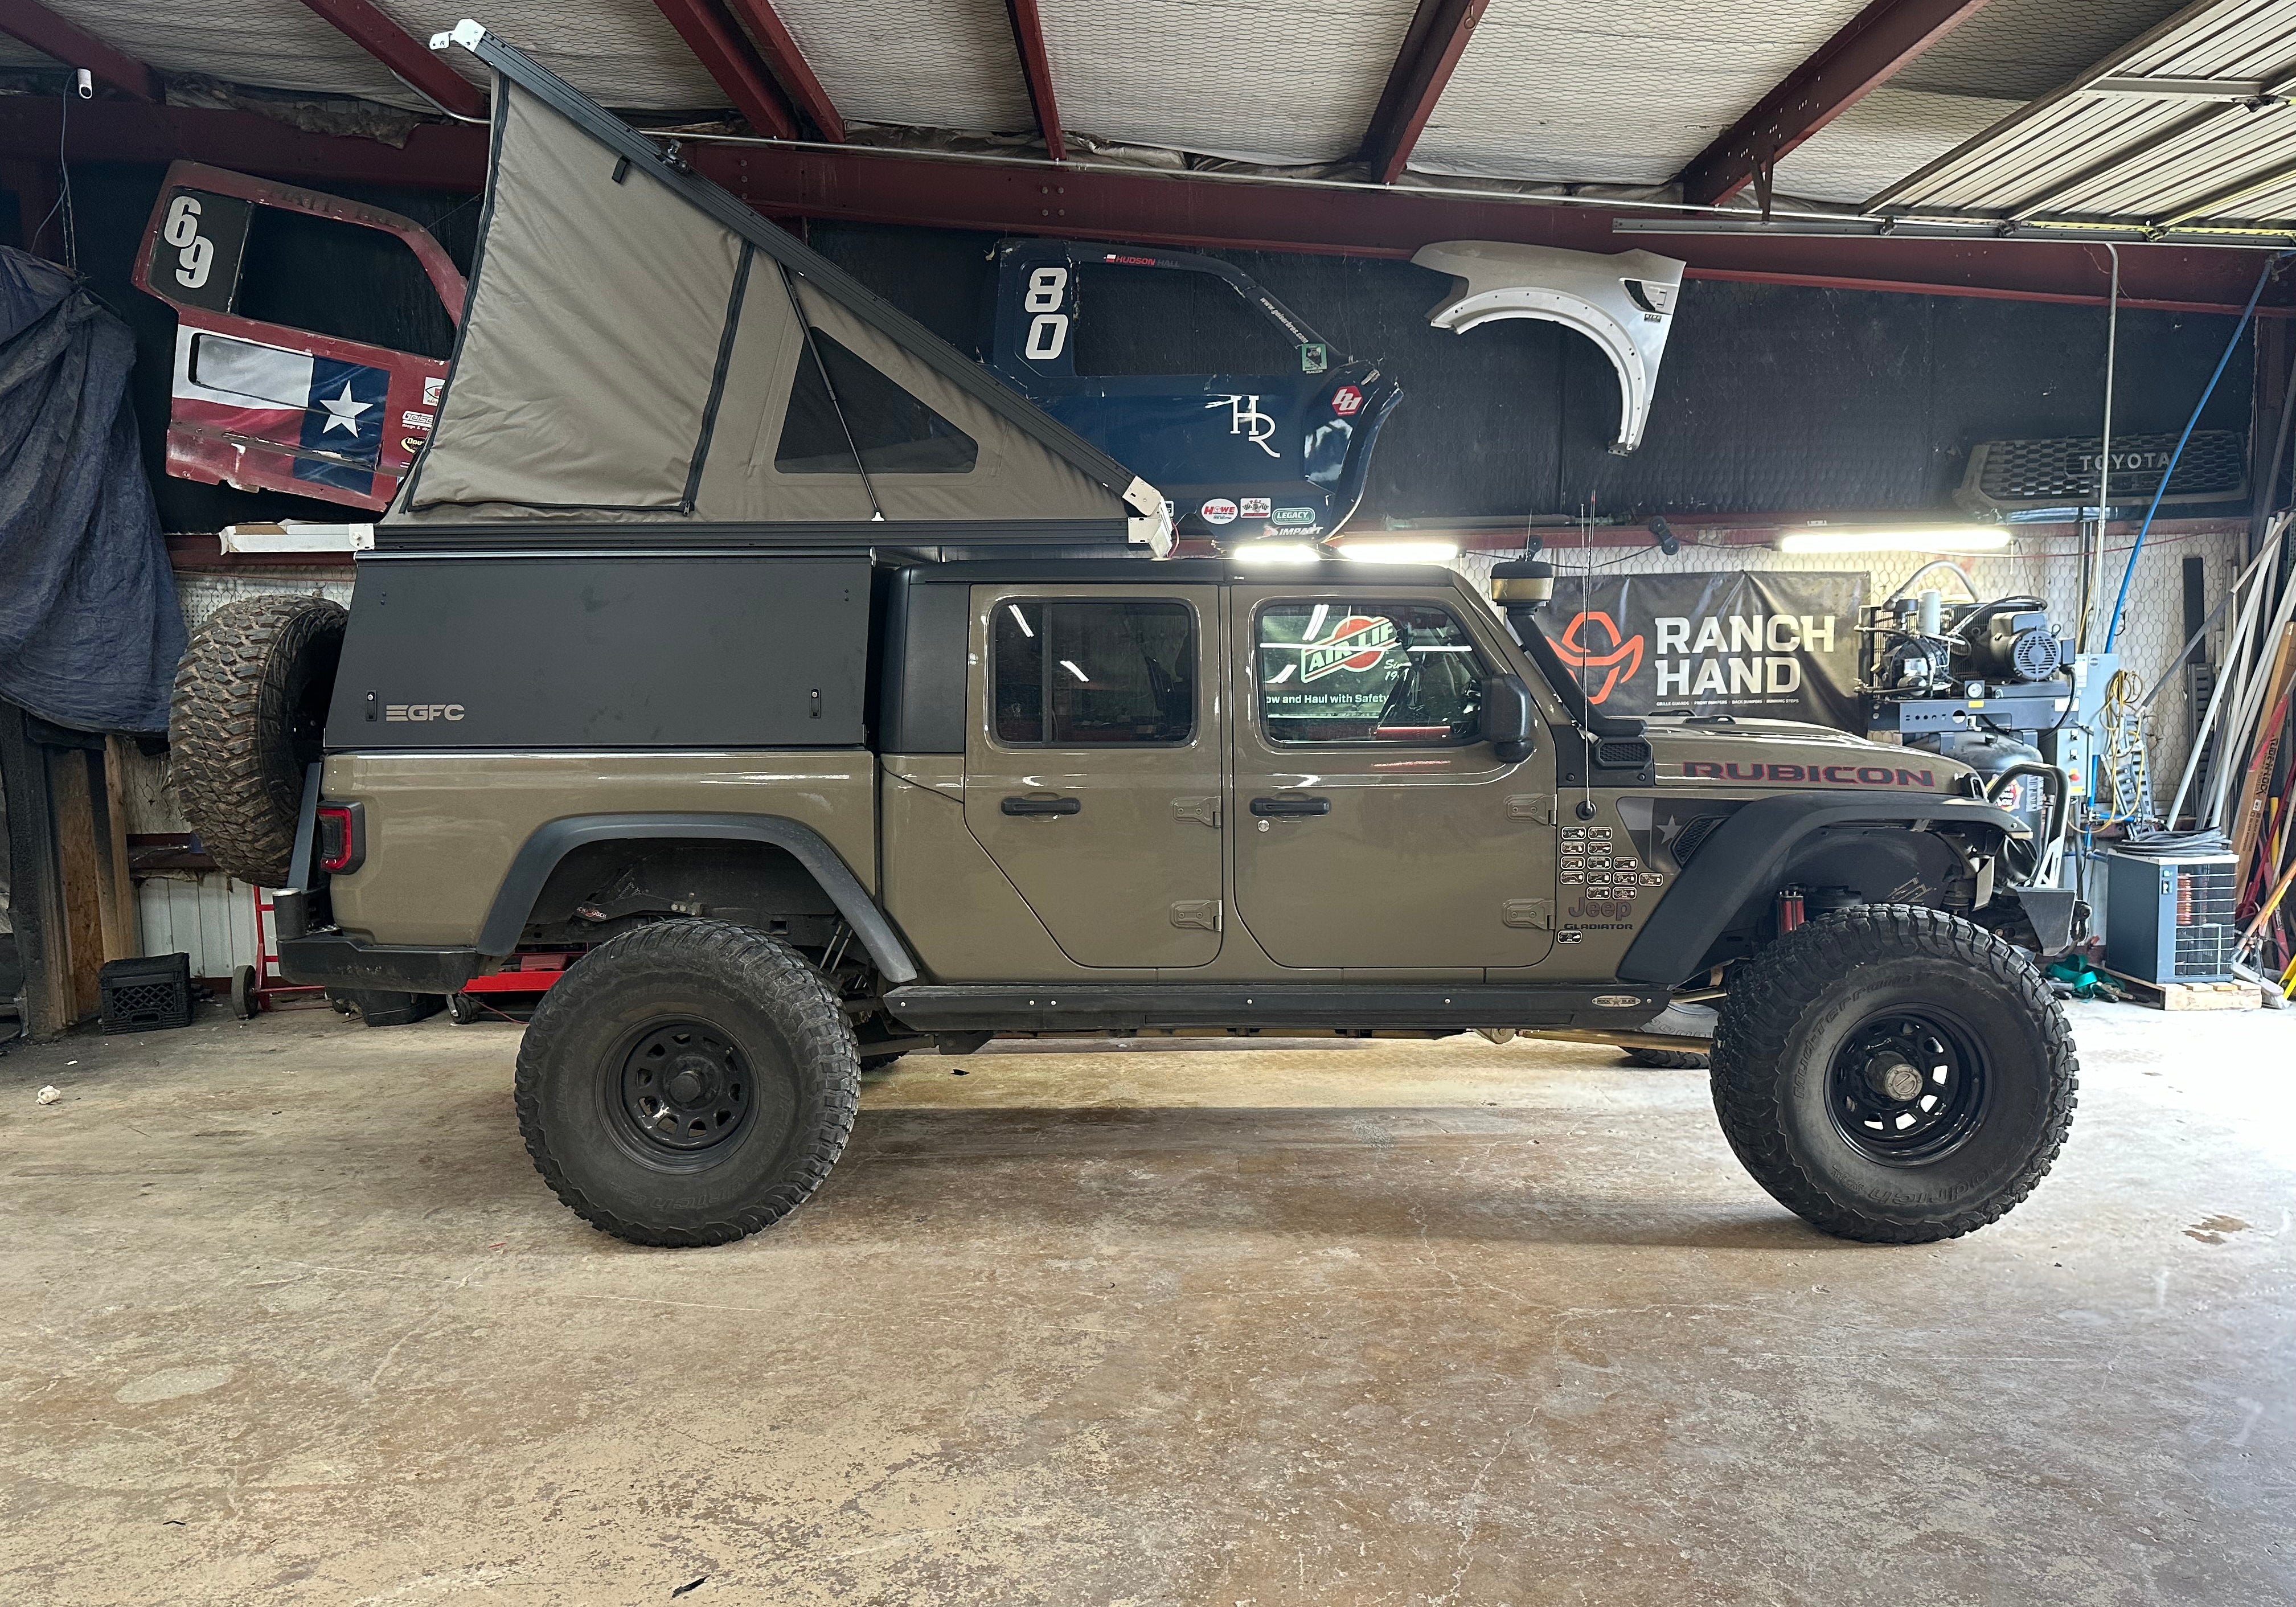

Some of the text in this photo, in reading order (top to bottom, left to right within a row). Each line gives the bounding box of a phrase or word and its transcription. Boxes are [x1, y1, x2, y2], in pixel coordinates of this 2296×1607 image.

[164, 196, 214, 288] 69
[1116, 256, 1156, 265] HUDSON
[1024, 267, 1068, 359] 80
[2079, 452, 2170, 471] TOYOTA
[1309, 624, 1394, 672] AIR LIF
[1655, 614, 1835, 654] RANCH
[1655, 657, 1801, 696] HAND
[1282, 694, 1302, 704] and
[1304, 694, 1328, 704] Haul
[1330, 694, 1352, 703] with
[1355, 693, 1390, 704] Safety
[1682, 761, 1935, 787] RUBICON
[1568, 896, 1632, 921] Jeep
